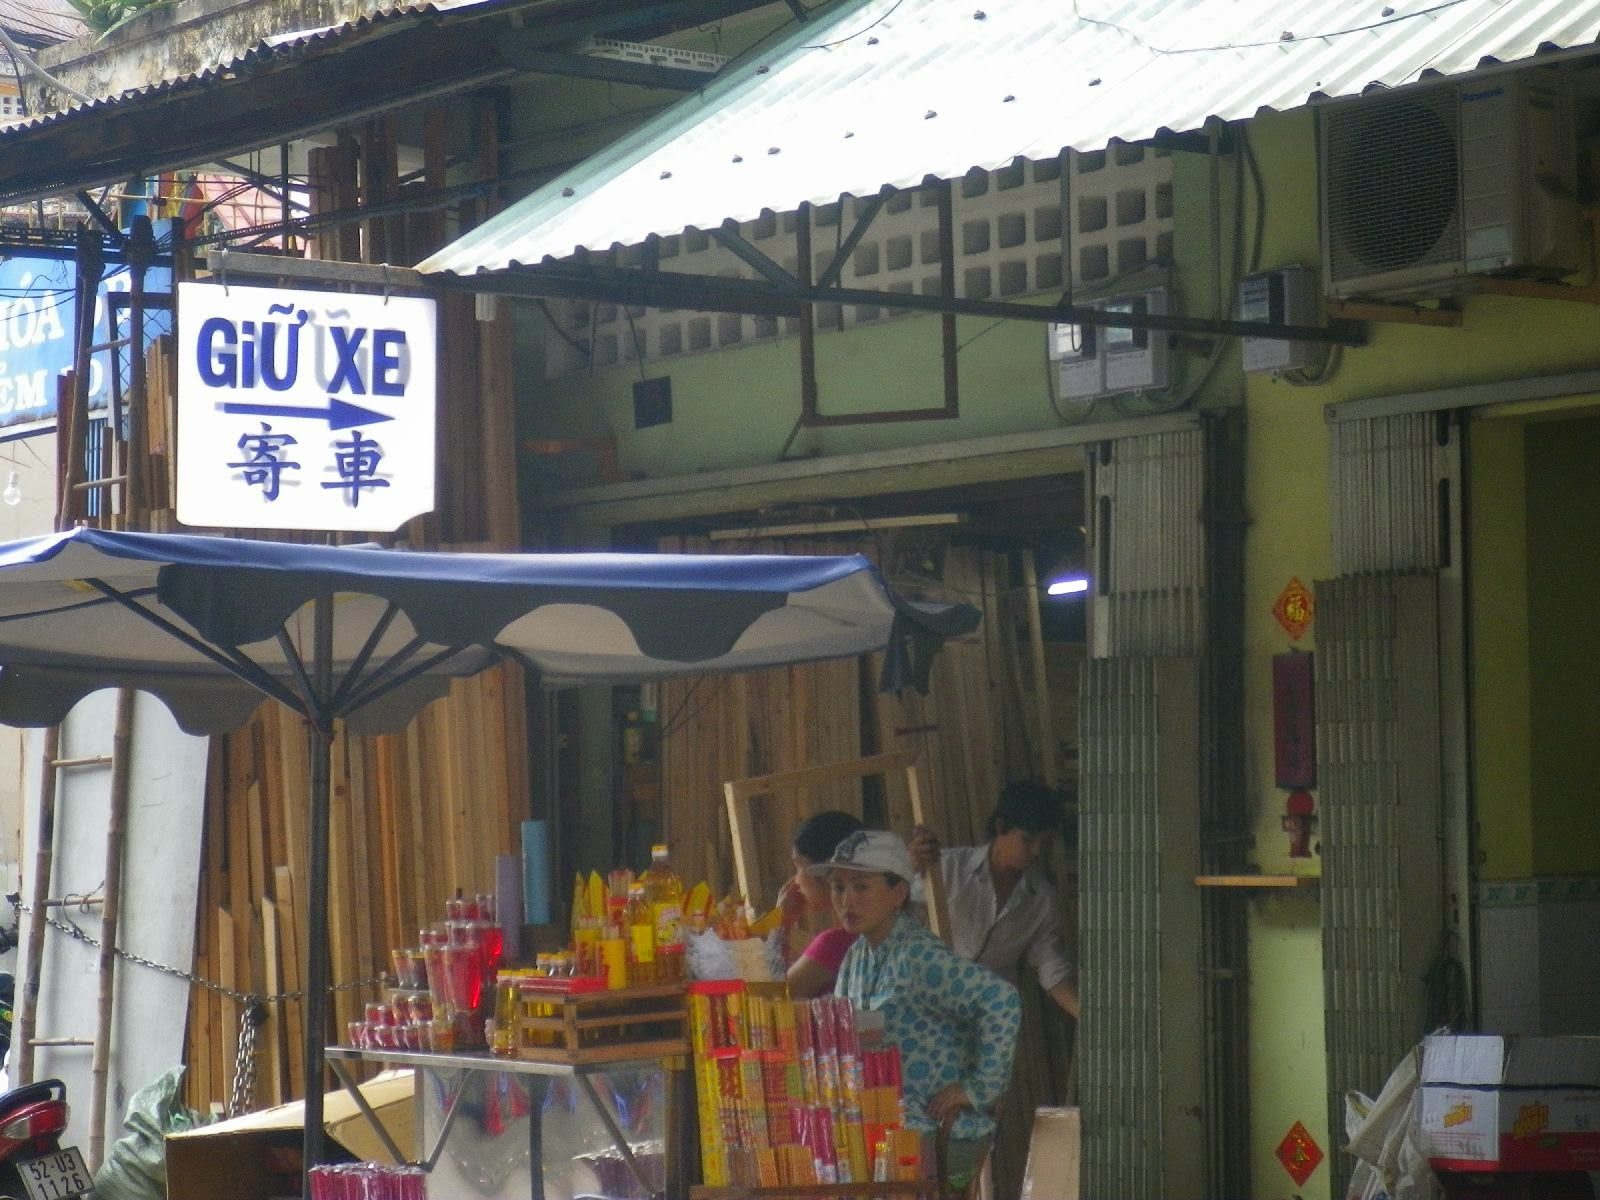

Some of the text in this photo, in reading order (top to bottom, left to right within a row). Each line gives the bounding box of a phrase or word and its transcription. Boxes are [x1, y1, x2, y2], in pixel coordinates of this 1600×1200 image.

[327, 326, 406, 397] XE
[226, 421, 390, 509] 寄車
[38, 1173, 85, 1200] 1126
